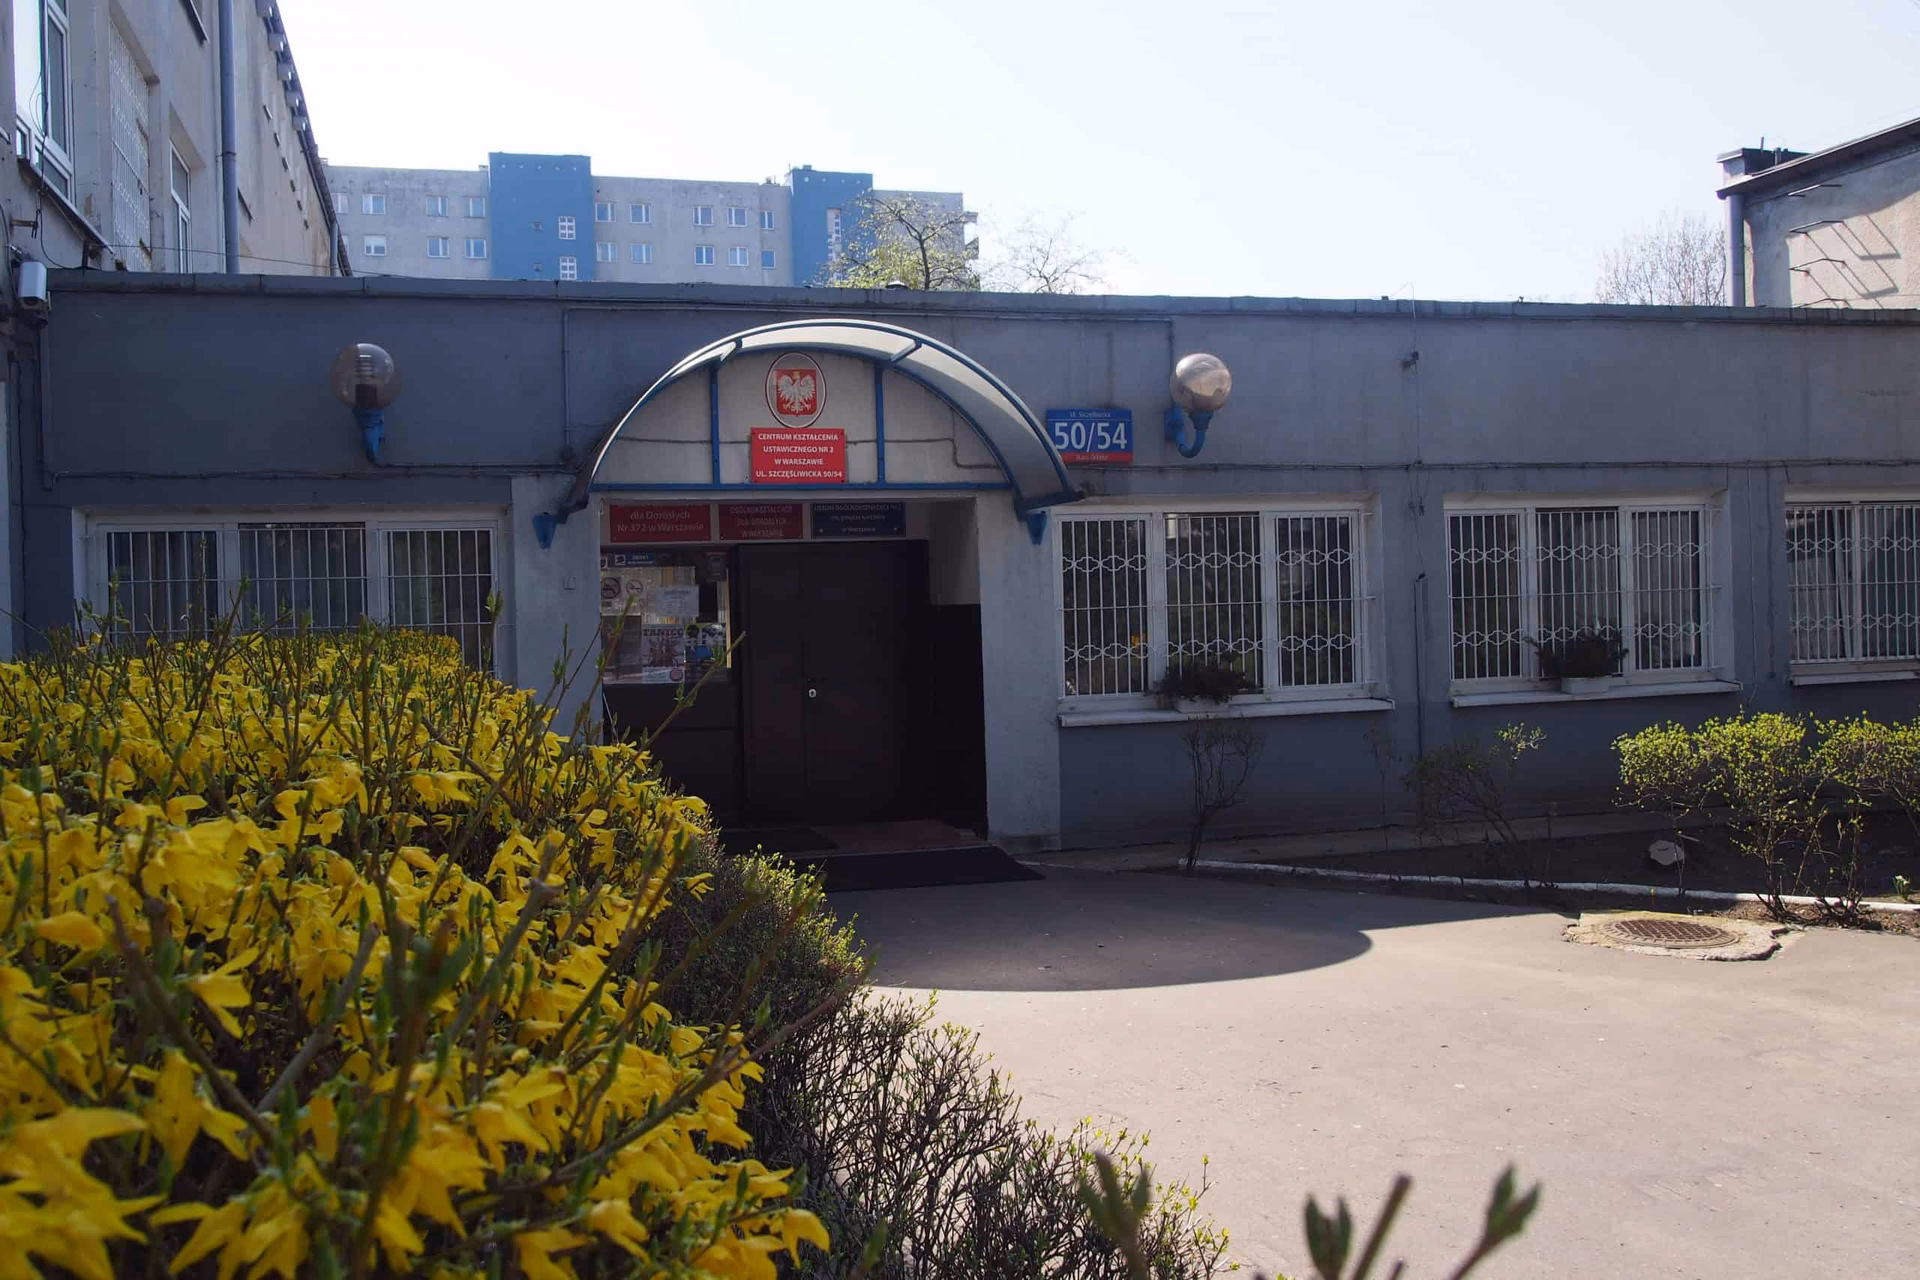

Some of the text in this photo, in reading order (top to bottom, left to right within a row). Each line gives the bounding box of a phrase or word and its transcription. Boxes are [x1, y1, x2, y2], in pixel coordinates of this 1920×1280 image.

[1054, 421, 1128, 453] 50/54
[768, 470, 822, 479] SZCZĘŚLIWICKA
[630, 510, 690, 521] dla Dorosłych
[617, 523, 628, 532] Nr
[629, 523, 647, 532] 372
[657, 522, 704, 532] Warszawie
